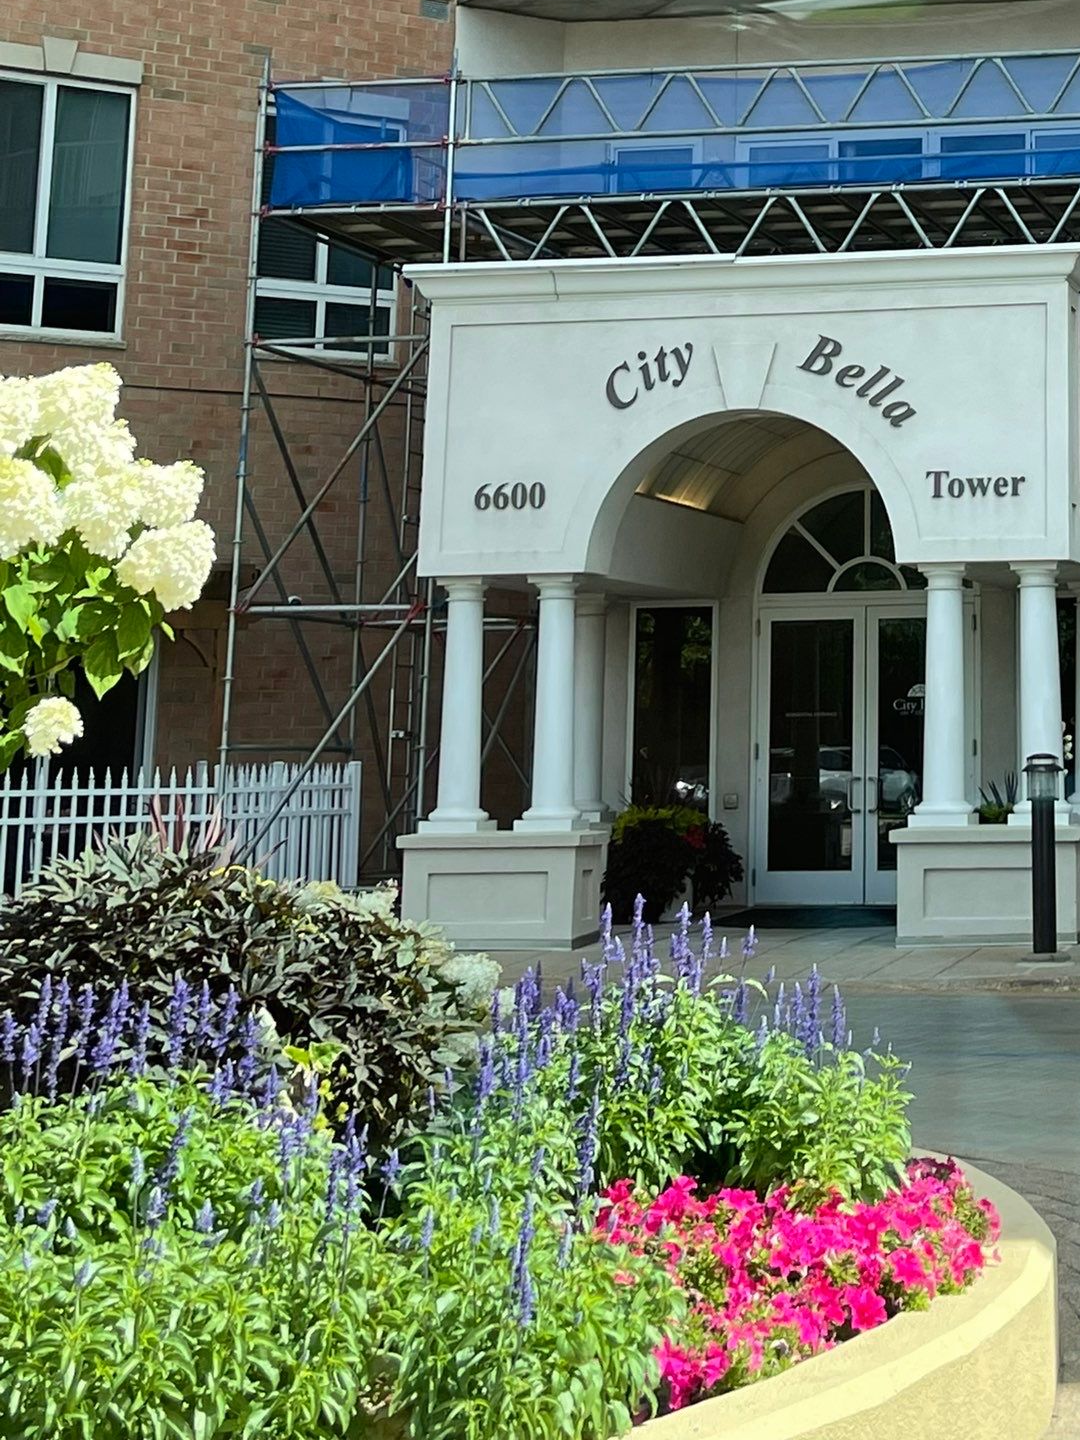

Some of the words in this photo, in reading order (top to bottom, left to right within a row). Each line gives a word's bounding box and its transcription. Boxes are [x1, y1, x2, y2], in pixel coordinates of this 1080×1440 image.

[605, 342, 694, 411] City
[796, 334, 917, 429] Bella
[474, 481, 546, 511] 6600
[925, 470, 1026, 499] Tower
[892, 698, 918, 714] City
